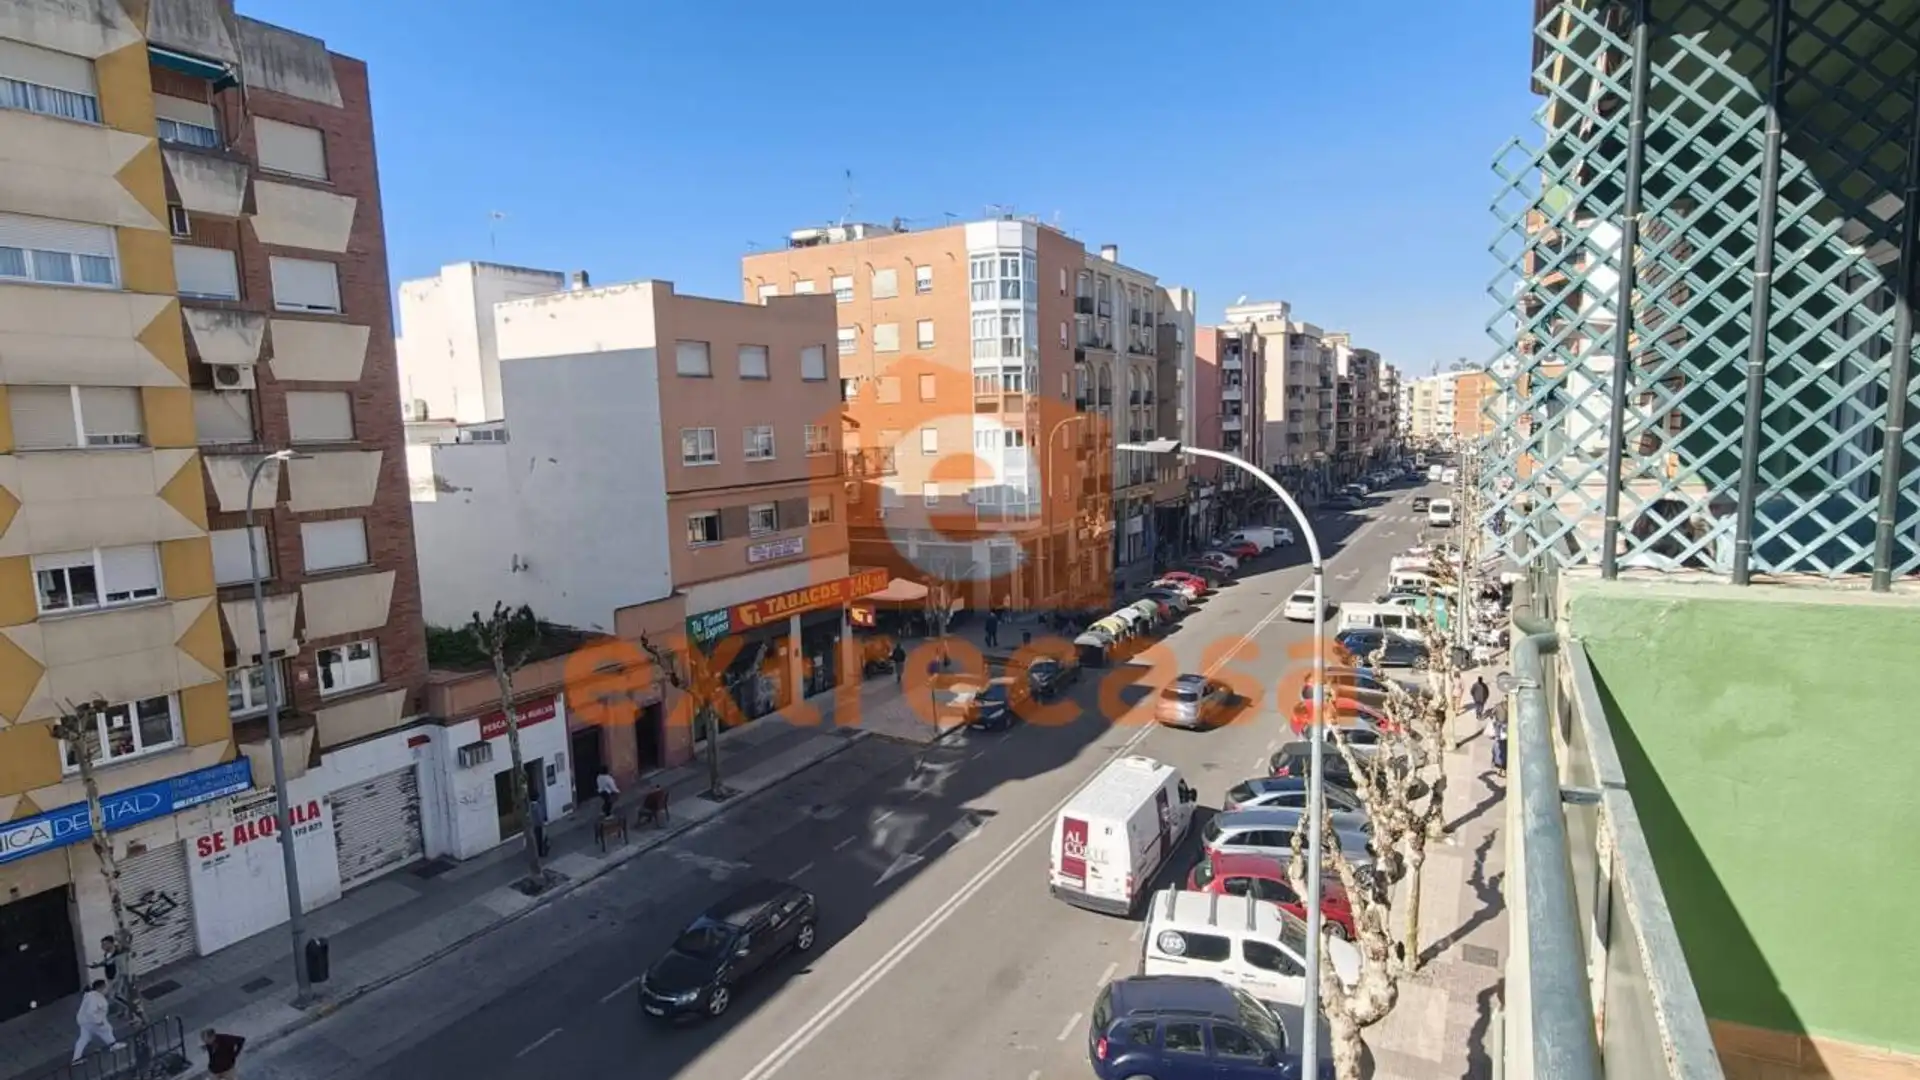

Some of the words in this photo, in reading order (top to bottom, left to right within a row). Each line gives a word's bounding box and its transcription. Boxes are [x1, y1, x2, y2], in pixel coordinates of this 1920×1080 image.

[764, 581, 840, 614] TABACOS
[702, 609, 728, 627] Tienda
[0, 825, 49, 850] ICA
[197, 830, 226, 858] SE
[1065, 829, 1083, 845] AL
